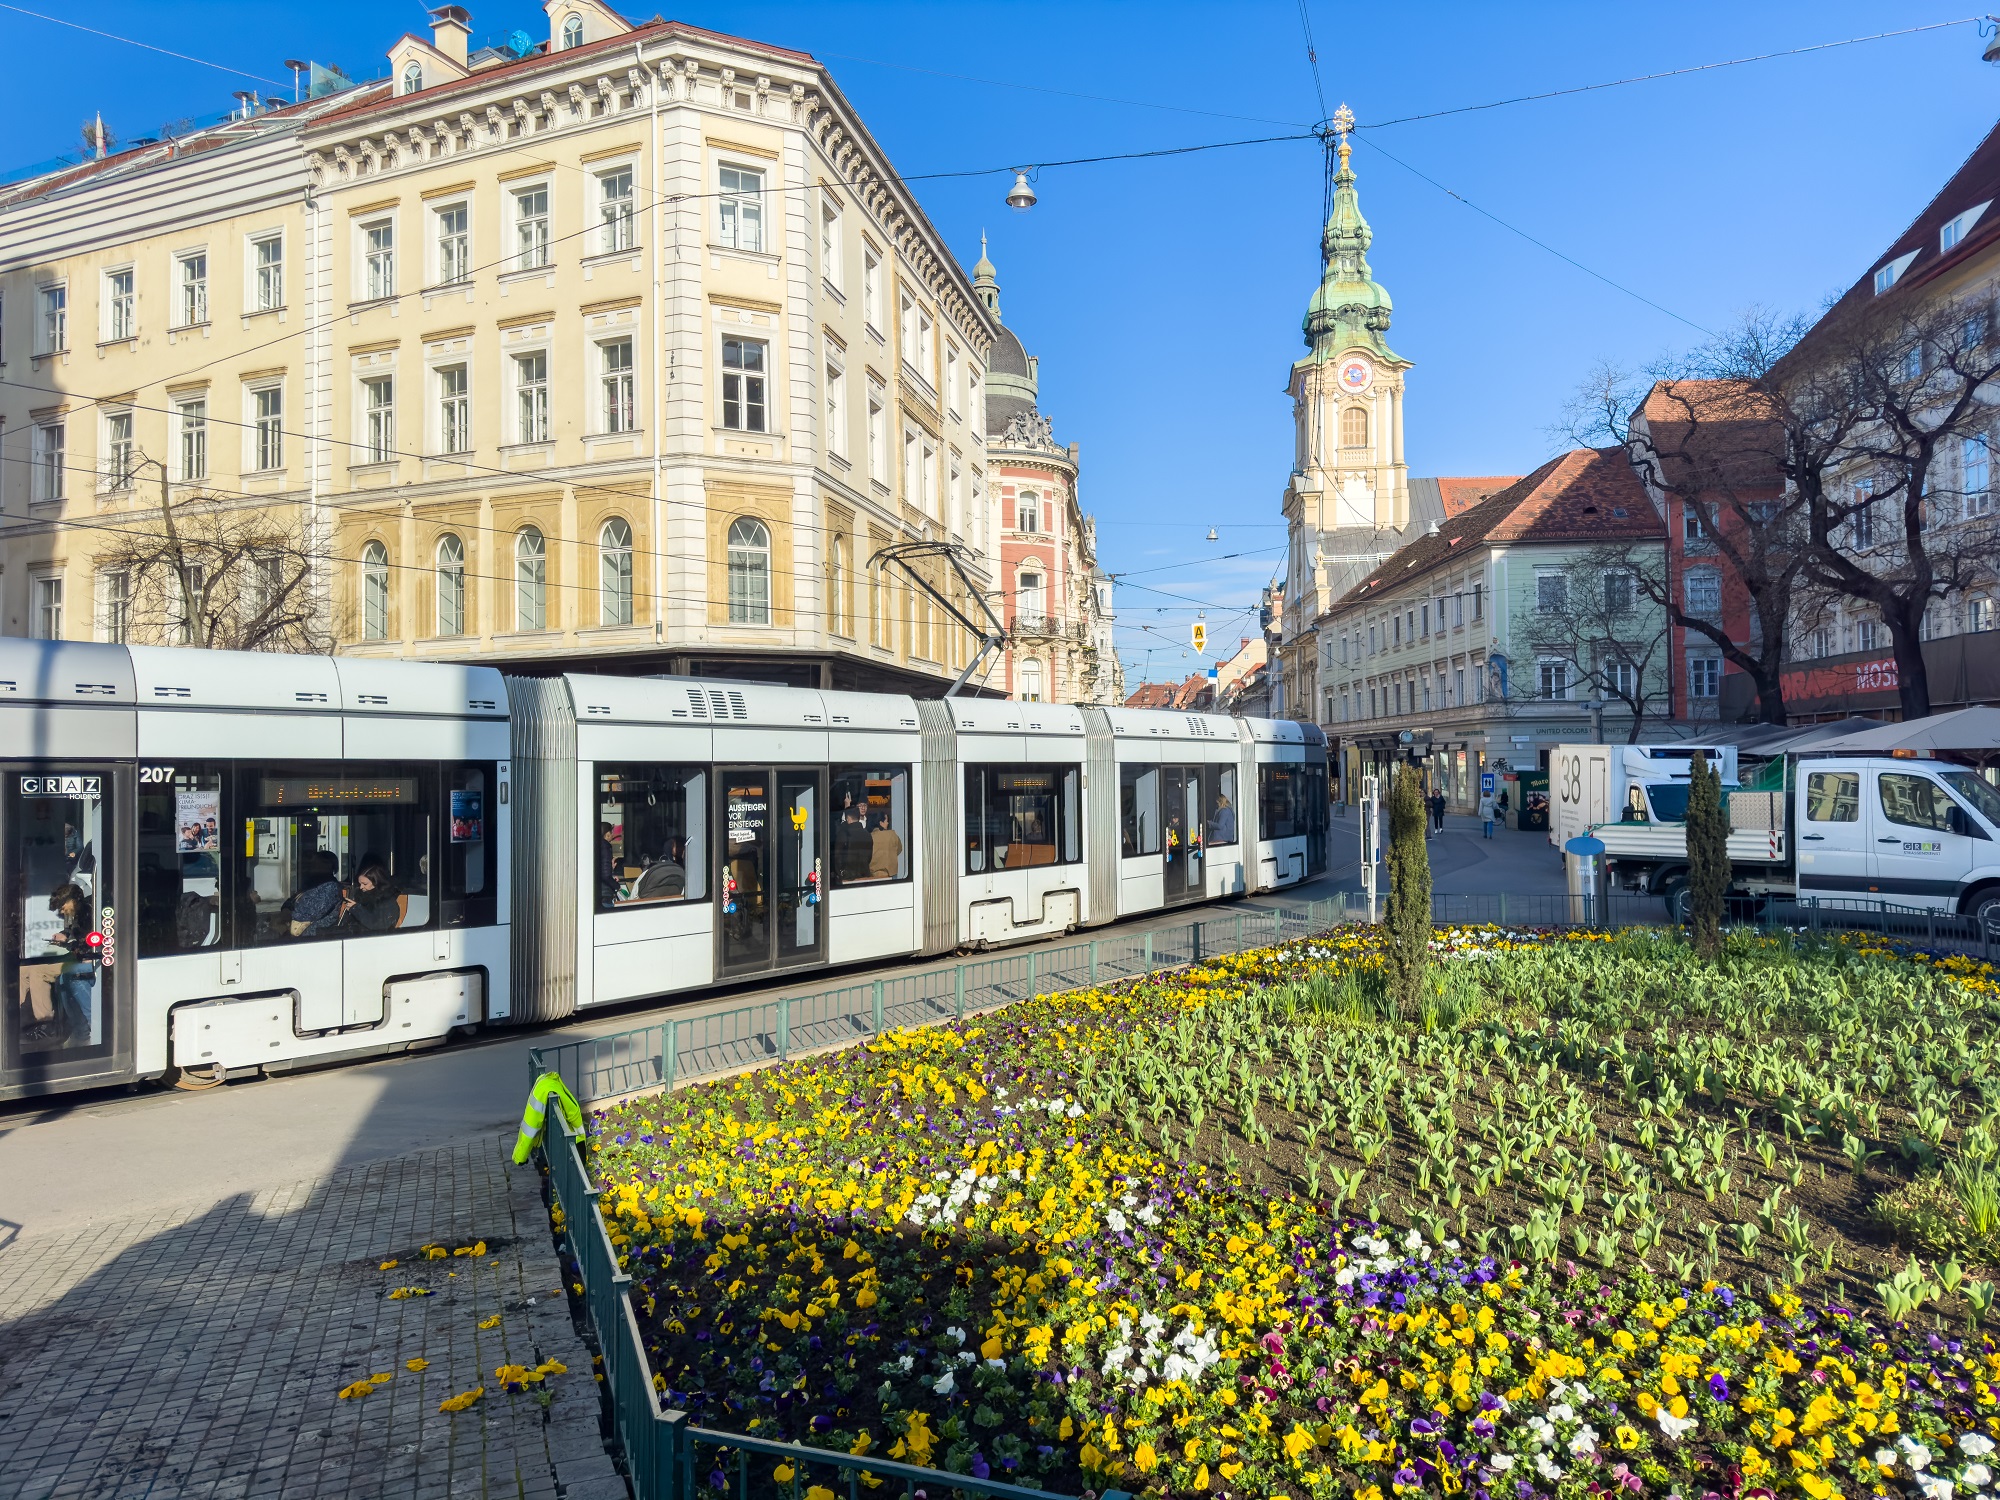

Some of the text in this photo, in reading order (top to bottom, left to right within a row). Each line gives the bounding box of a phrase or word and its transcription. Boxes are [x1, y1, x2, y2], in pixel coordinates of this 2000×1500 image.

[1194, 626, 1204, 639] A
[139, 767, 175, 783] 207
[1560, 754, 1581, 805] 38
[21, 776, 101, 794] GRAZ
[729, 803, 767, 811] AUSSTEIGEN
[729, 820, 763, 828] EINSTEIGEN
[1903, 843, 1941, 851] GRAZ
